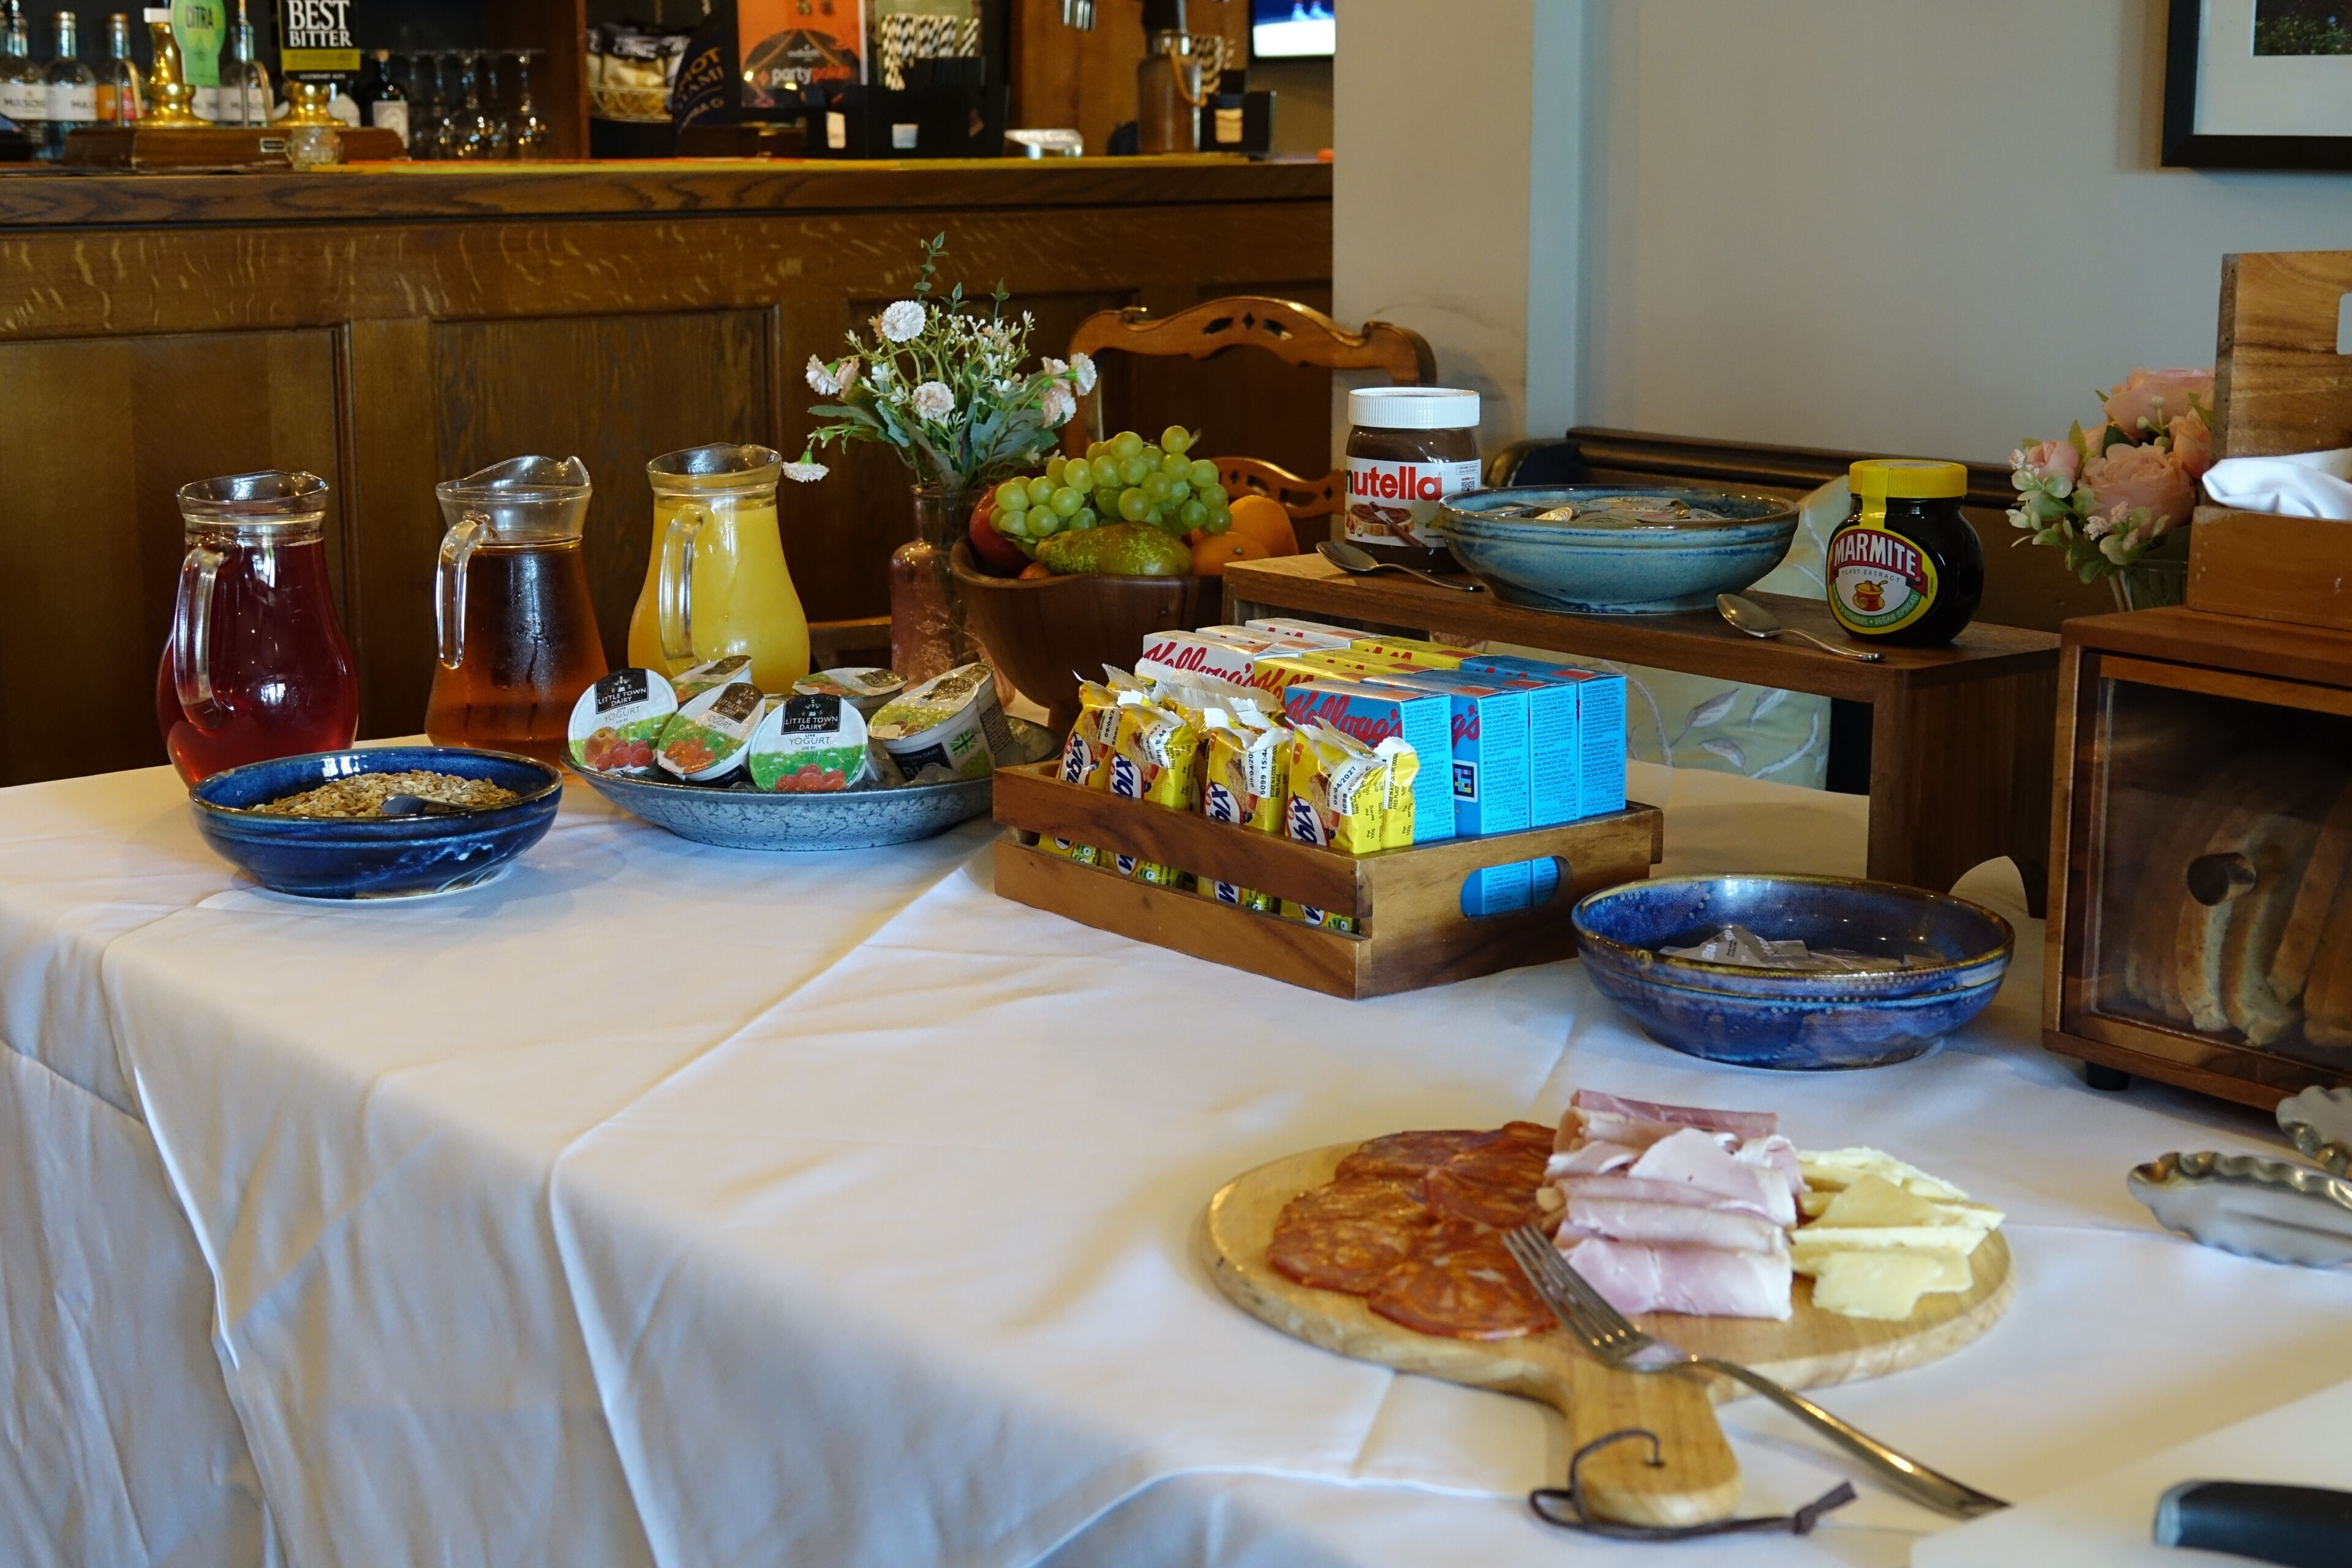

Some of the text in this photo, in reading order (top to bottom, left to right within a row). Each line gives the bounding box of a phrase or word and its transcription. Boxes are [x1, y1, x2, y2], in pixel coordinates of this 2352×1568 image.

[288, 0, 350, 30] BEST
[289, 31, 353, 47] BITTER
[1346, 465, 1442, 502] nutella
[1834, 533, 1917, 576] MARMITE
[1863, 569, 1901, 582] EXTRACT
[1897, 594, 1919, 617] SPREAD
[598, 687, 647, 705] LITTLE TOWN
[611, 696, 633, 707] DAIRY
[604, 706, 641, 723] YOGURT
[706, 714, 733, 729] YOGURT
[789, 736, 831, 745] YOGURT
[1333, 766, 1355, 805] 09/04/2027
